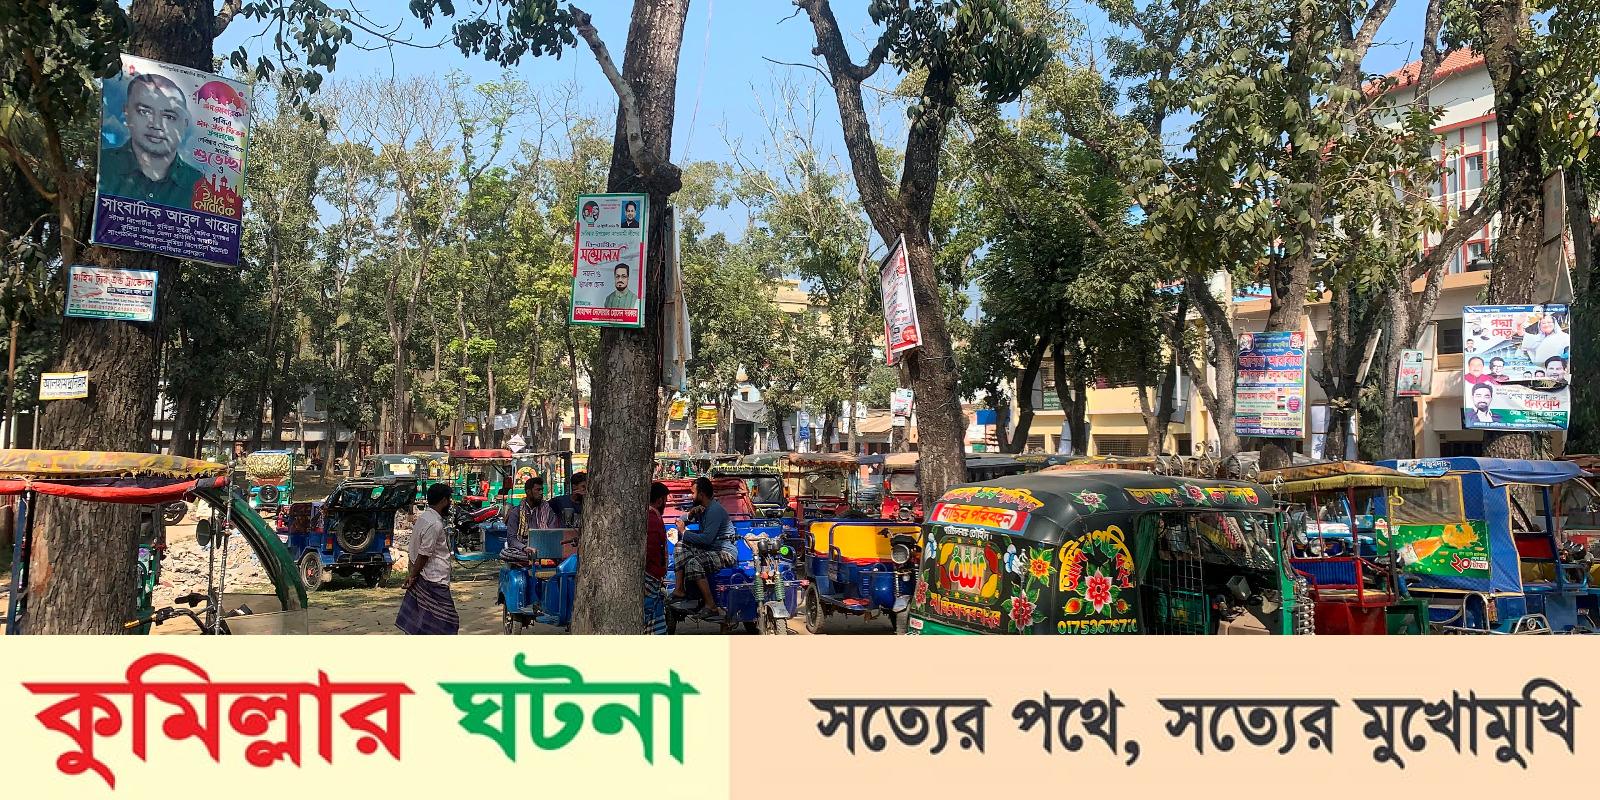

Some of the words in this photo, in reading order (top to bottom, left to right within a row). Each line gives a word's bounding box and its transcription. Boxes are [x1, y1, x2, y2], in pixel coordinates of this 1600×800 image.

[193, 148, 242, 175] শুভেচ্ছা
[101, 197, 162, 219] সাংবাদিক
[165, 209, 201, 228] আবুল
[204, 216, 238, 235] খায়ের
[193, 200, 236, 217] মোবারক
[580, 244, 627, 266] সম্মেলন
[1491, 319, 1513, 328] পদ্মা
[1492, 328, 1513, 340] সেতু
[1524, 399, 1561, 411] ধন্যবাদ
[971, 506, 1015, 527] পরিবহন
